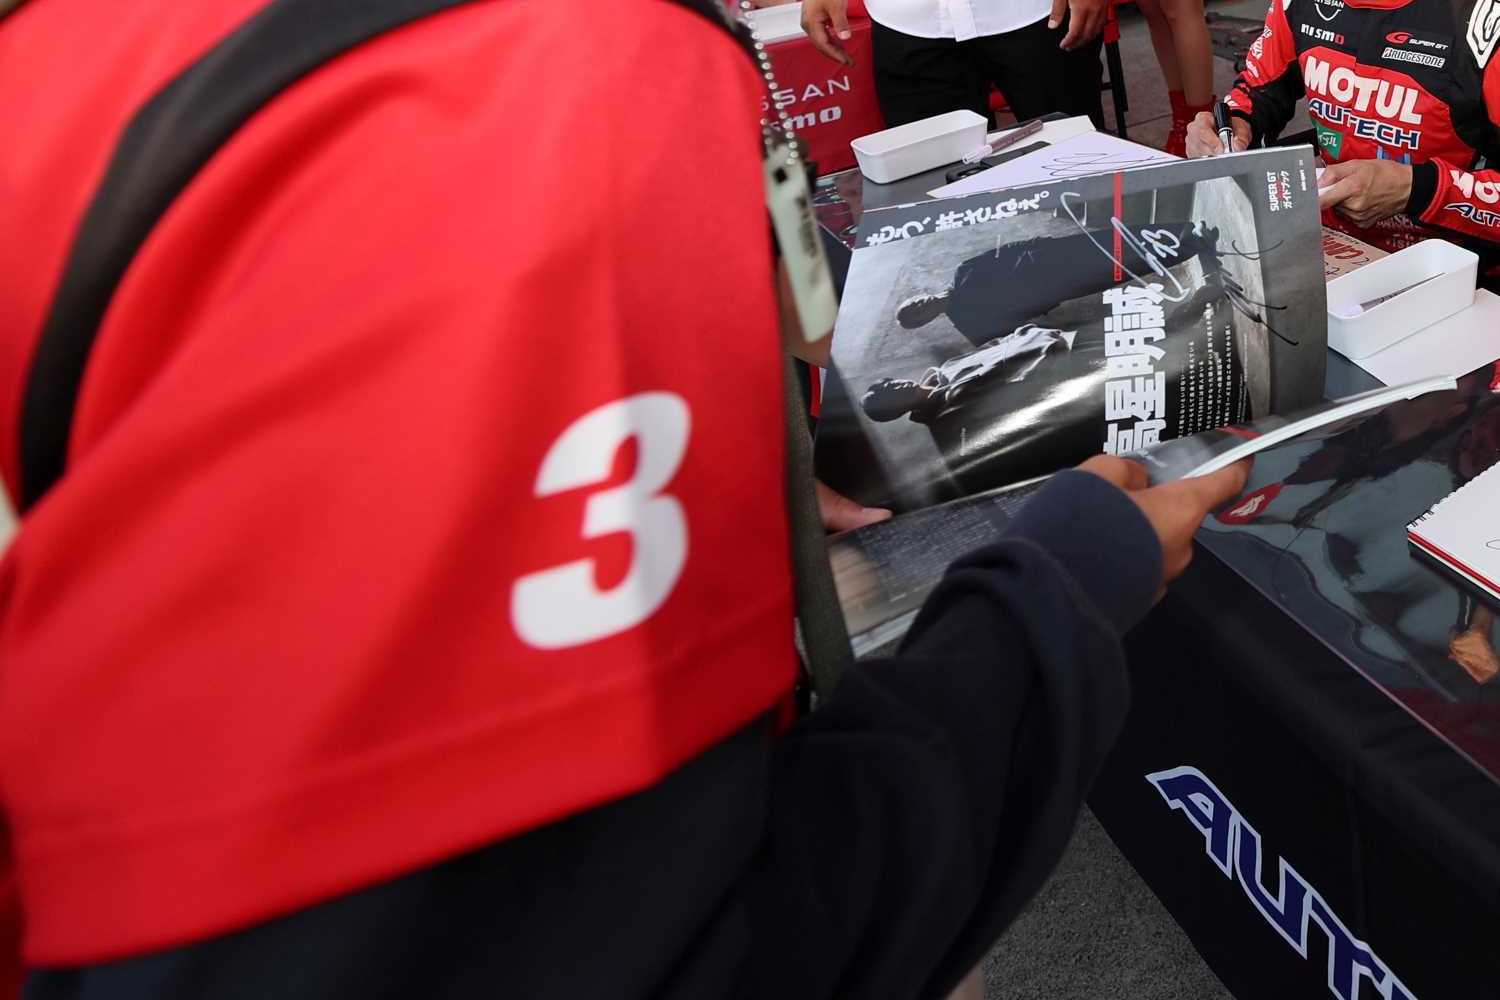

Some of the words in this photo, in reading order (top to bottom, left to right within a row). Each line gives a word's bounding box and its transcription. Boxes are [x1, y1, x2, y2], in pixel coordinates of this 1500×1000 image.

[1301, 24, 1345, 45] nismo
[1409, 38, 1436, 47] SUPER
[1382, 47, 1446, 69] BRIDGESTONE
[1304, 56, 1422, 125] MOTUL
[1309, 97, 1422, 151] AUTECH
[1266, 171, 1277, 183] GT
[1268, 183, 1280, 212] SUPER
[510, 390, 692, 651] 3
[1144, 765, 1418, 1000] AUT
